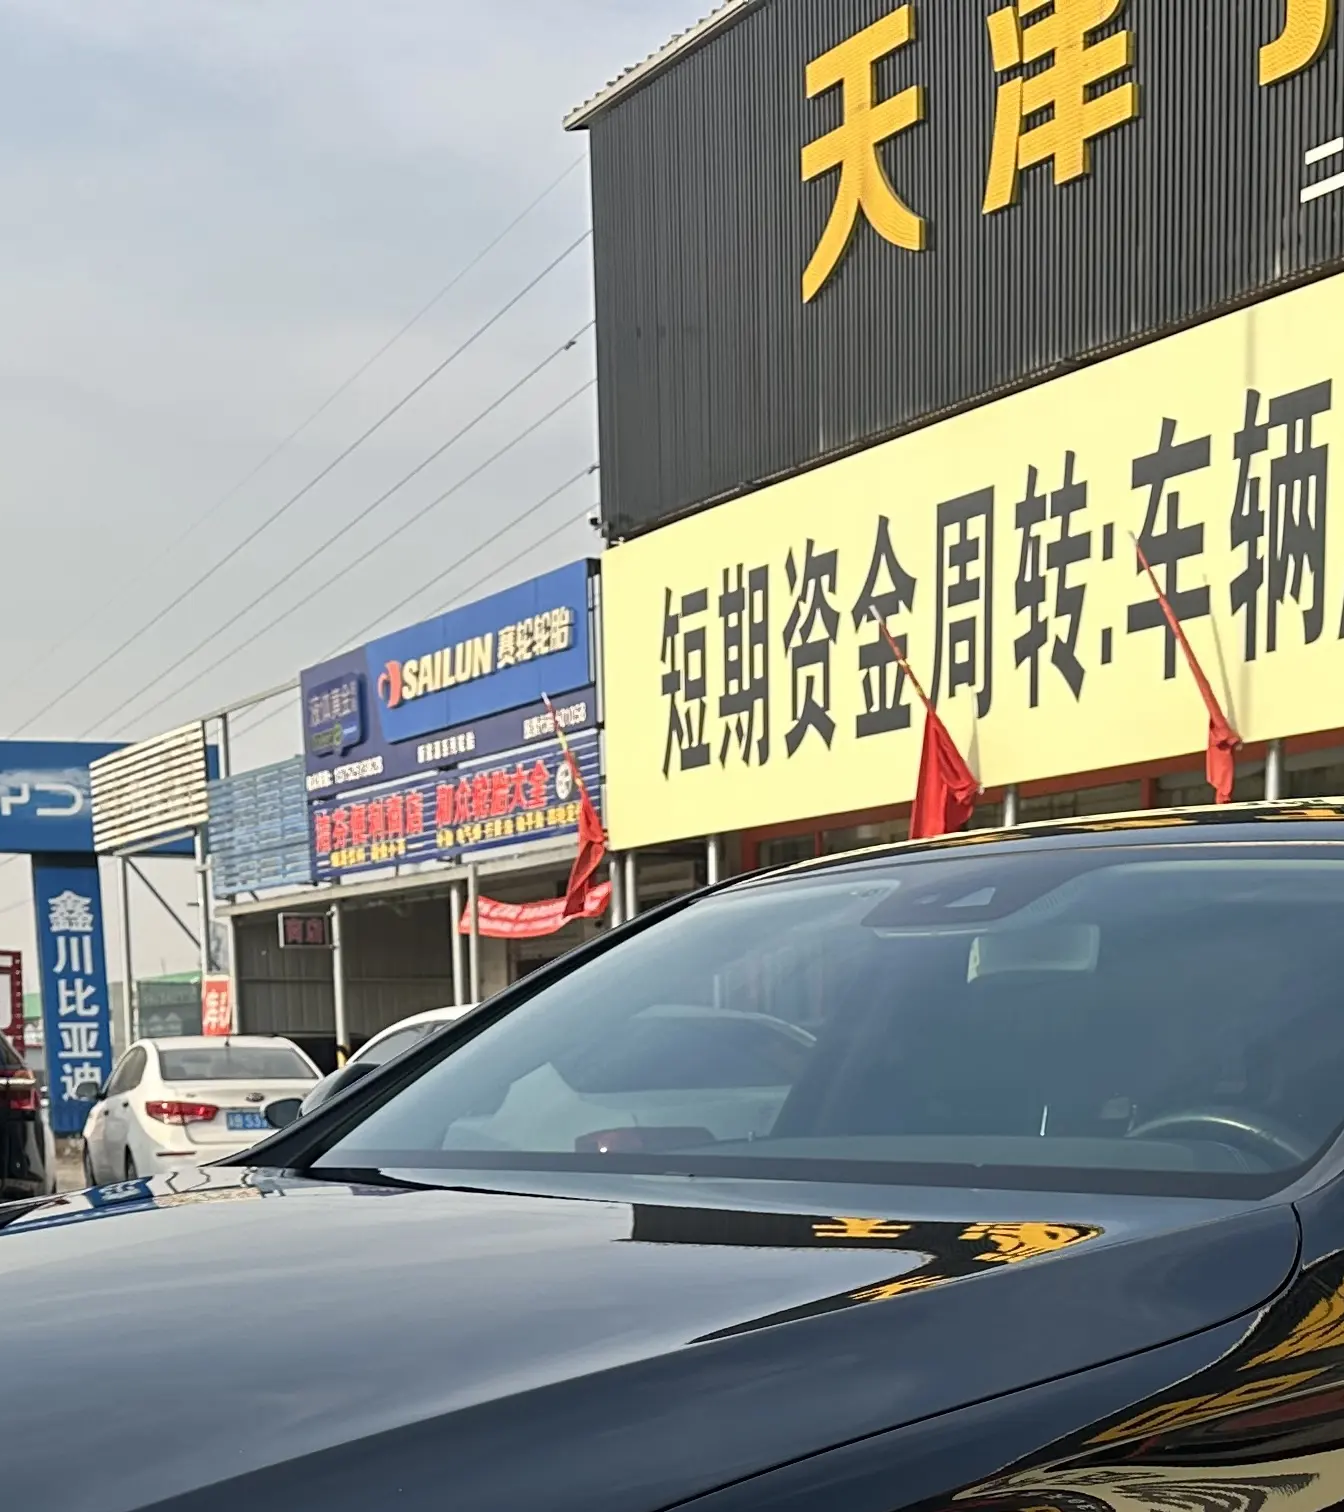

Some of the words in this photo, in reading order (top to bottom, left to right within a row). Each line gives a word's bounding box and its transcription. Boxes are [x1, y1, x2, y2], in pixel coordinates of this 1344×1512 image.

[401, 632, 494, 700] SAILUN
[48, 890, 103, 1101] 鑫川比亚迪
